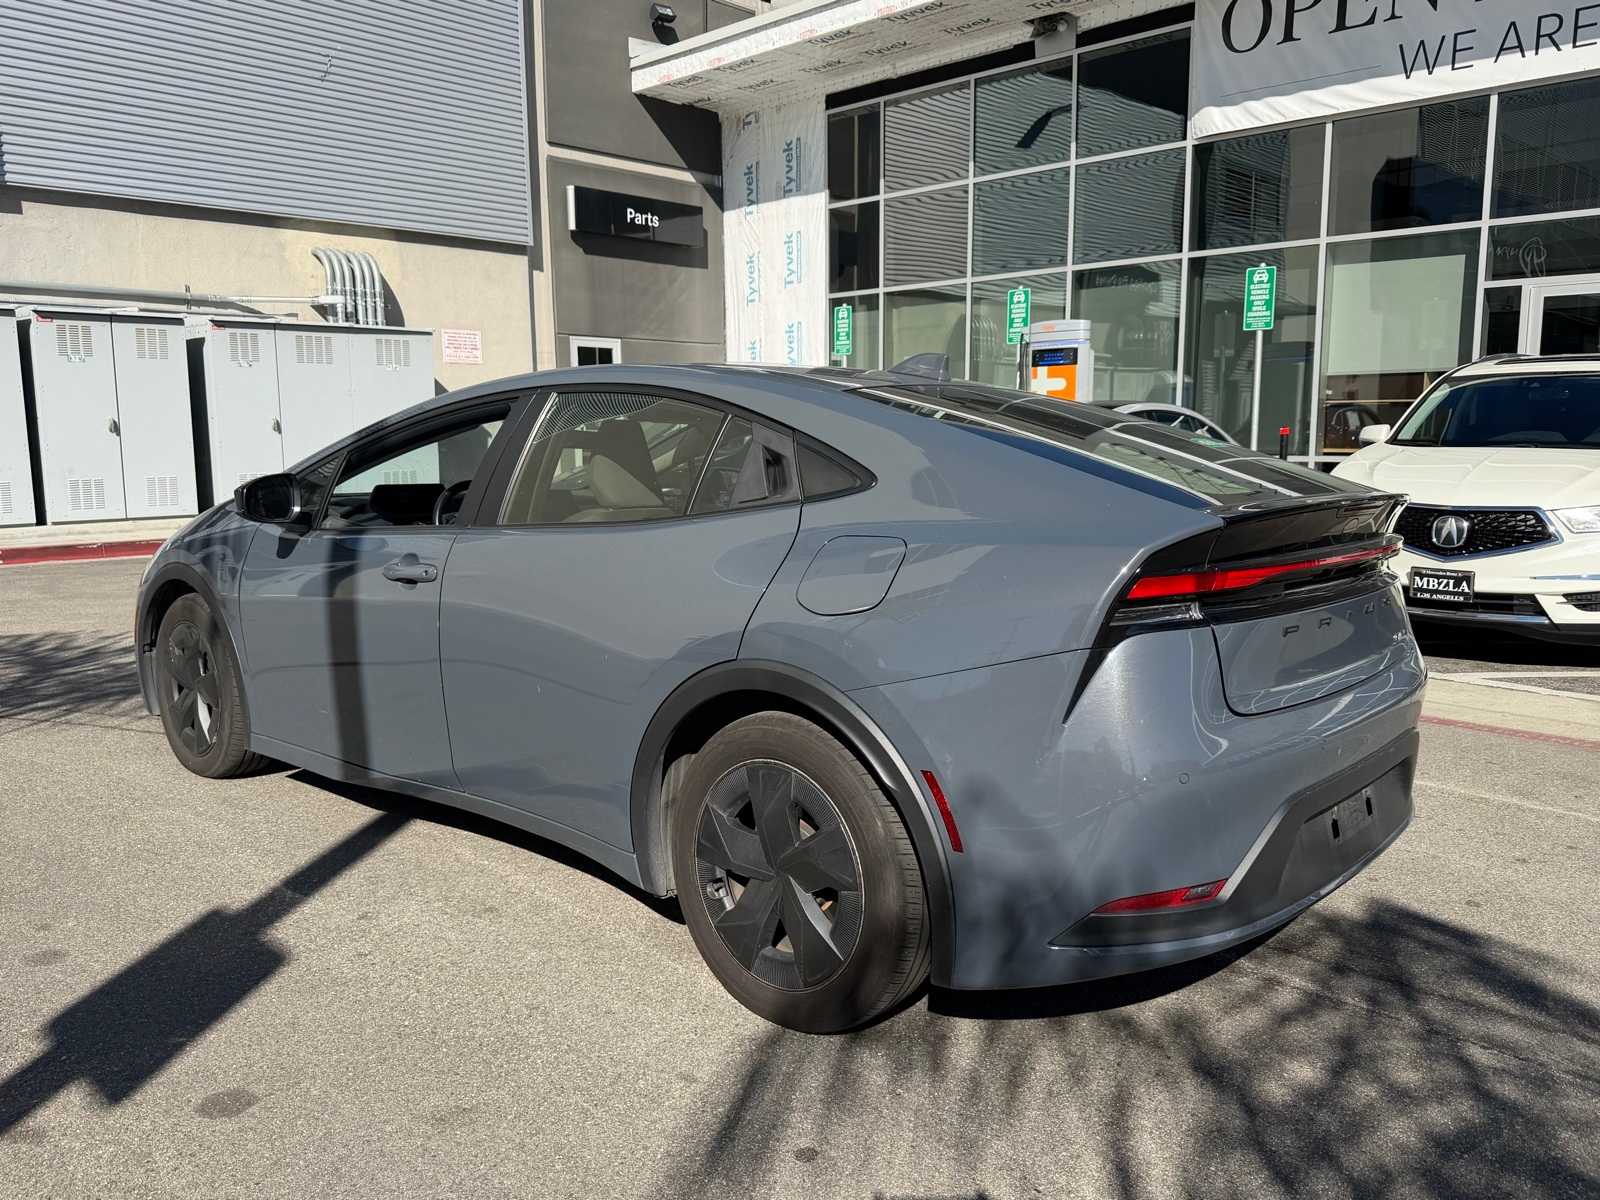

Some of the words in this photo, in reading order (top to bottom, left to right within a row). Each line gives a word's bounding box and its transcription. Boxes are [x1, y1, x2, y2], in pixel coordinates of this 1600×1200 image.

[884, 1, 945, 23] Tyvek
[807, 28, 851, 46] Tyvek
[943, 17, 992, 35] Tyvek
[864, 40, 909, 56] Tyvek
[1399, 28, 1478, 80] WE
[1494, 3, 1600, 63] ARE
[782, 139, 796, 199] Tyvek
[743, 161, 756, 221] Tyvek
[626, 207, 660, 228] Parts
[783, 231, 796, 289] Tyvek
[746, 253, 758, 307] Tyvek
[1413, 576, 1471, 593] MBZLA
